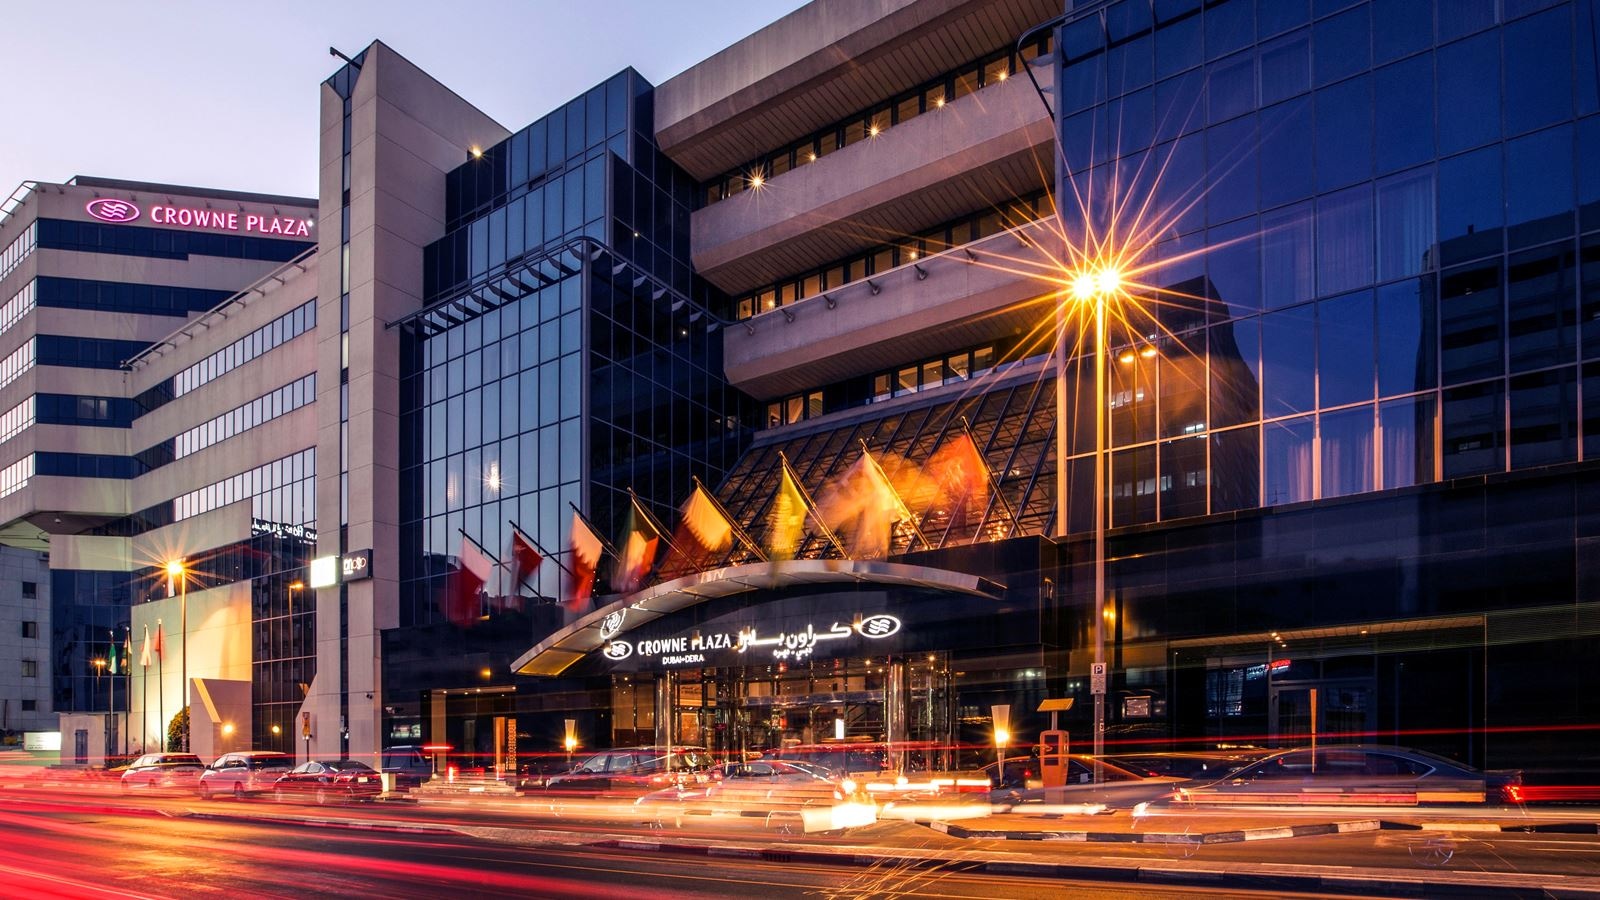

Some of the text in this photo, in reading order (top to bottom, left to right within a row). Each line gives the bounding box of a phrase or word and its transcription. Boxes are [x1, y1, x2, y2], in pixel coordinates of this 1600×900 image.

[151, 205, 310, 236] CROWNE PLAZA
[637, 633, 731, 655] CROWNE PLAZA
